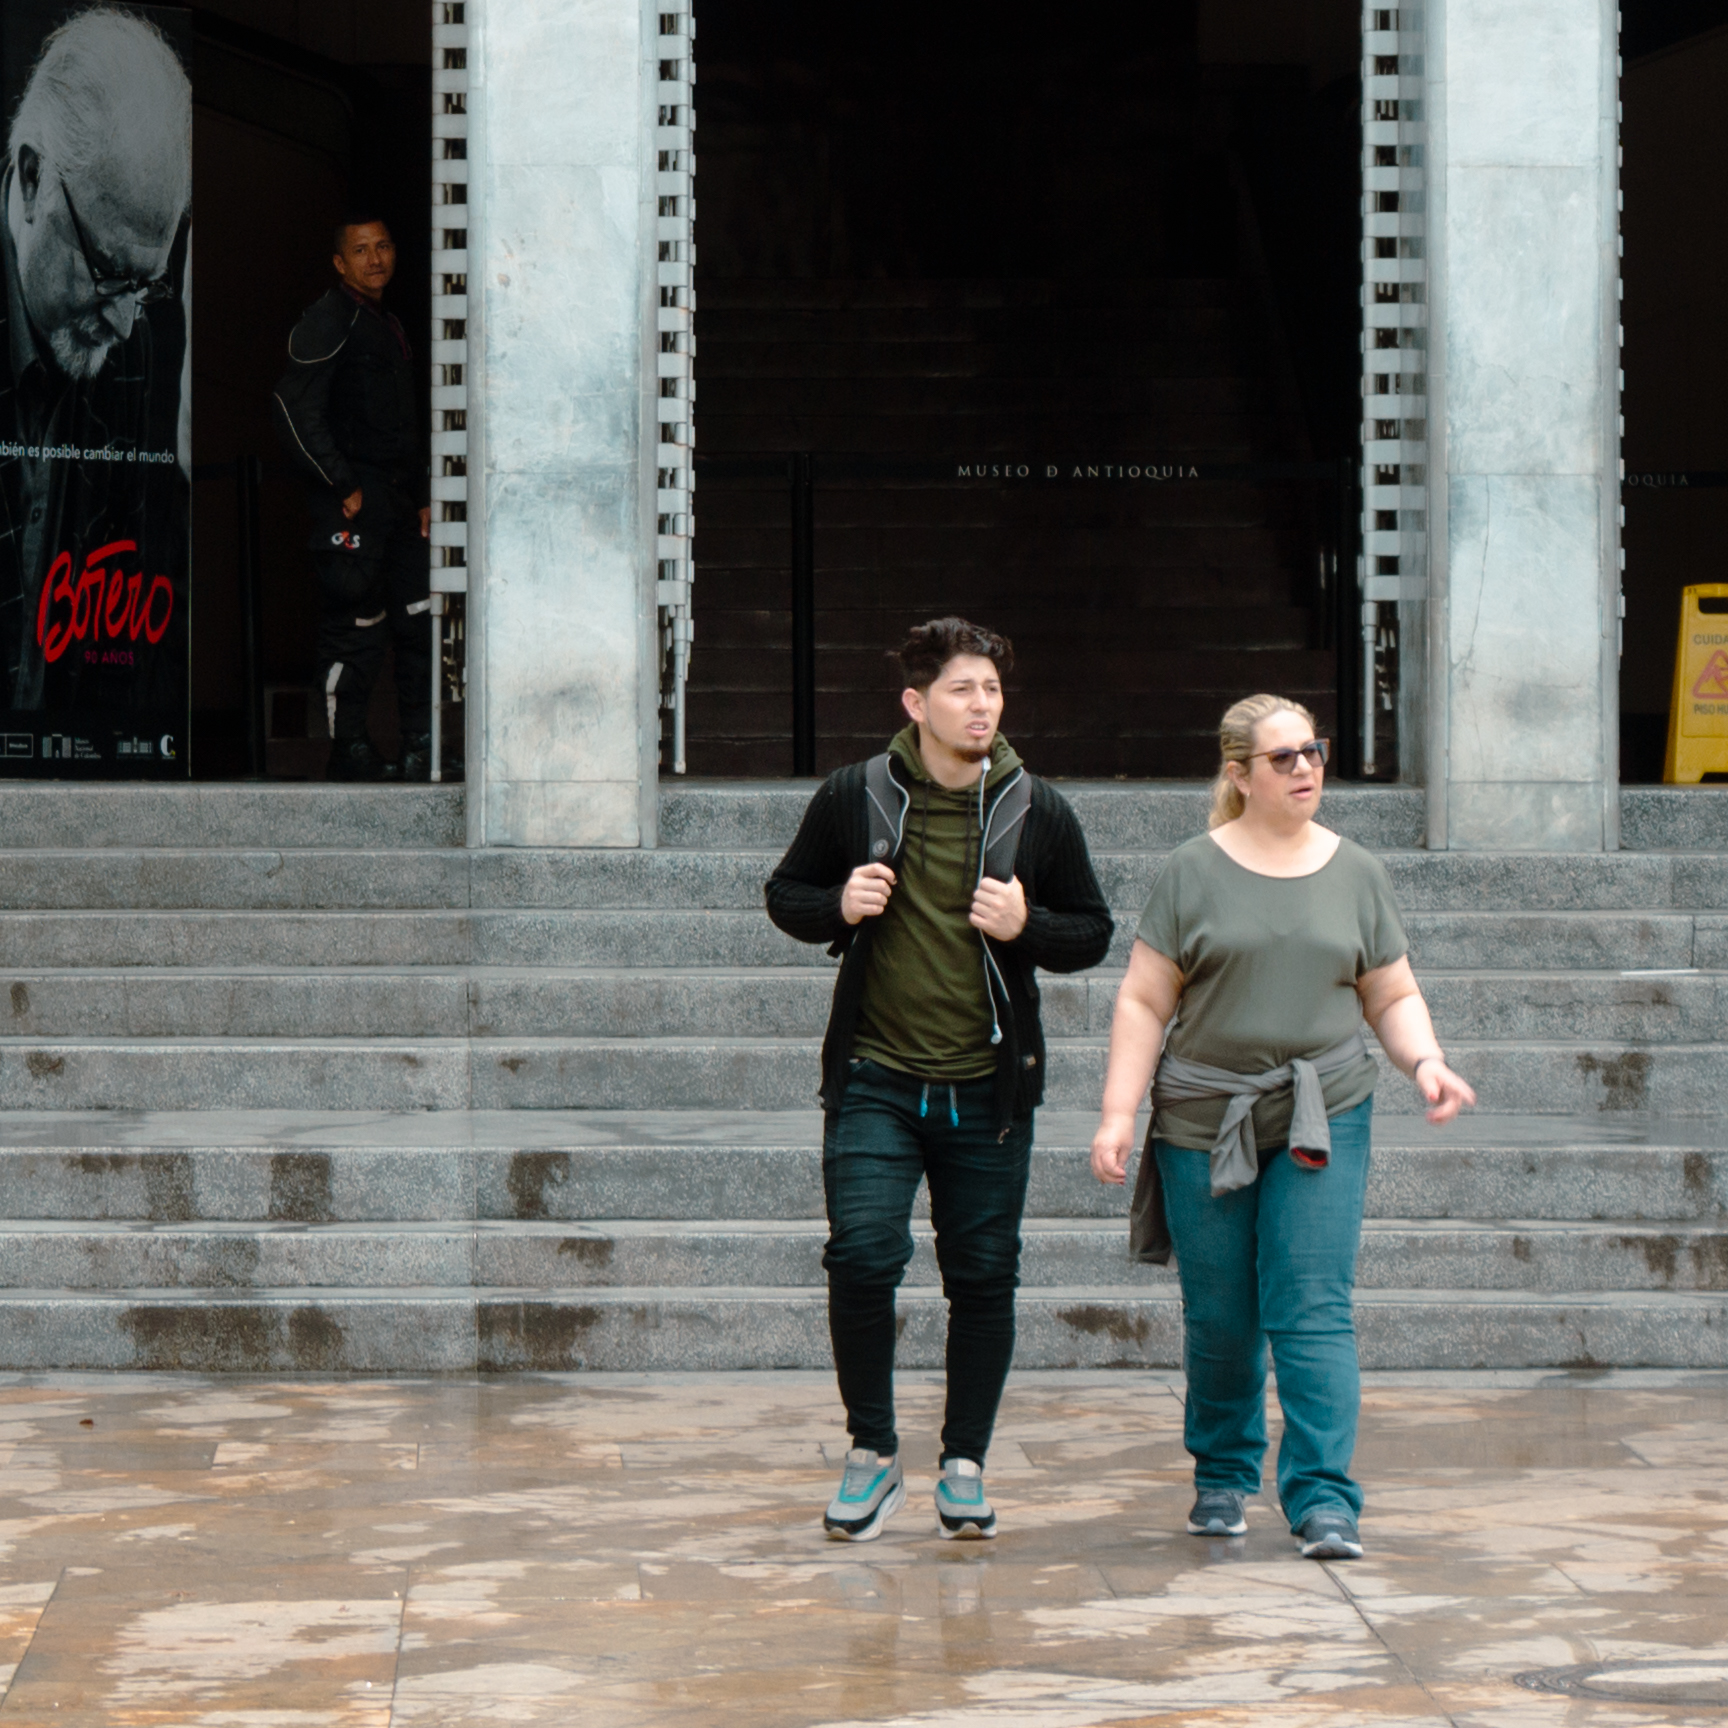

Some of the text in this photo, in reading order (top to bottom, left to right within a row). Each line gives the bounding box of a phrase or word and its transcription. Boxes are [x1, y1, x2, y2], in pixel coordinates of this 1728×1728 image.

[28, 445, 40, 458] es
[42, 443, 81, 463] posible
[83, 445, 124, 461] cambiar
[126, 446, 137, 462] el
[139, 448, 175, 464] mundo
[957, 464, 1030, 478] MUSEO
[1072, 464, 1199, 480] ANTIOQUIA
[1628, 474, 1689, 488] OQUIA
[36, 538, 175, 664] Botero
[84, 647, 134, 665] 90 AÑOS
[1694, 703, 1715, 715] PISO
